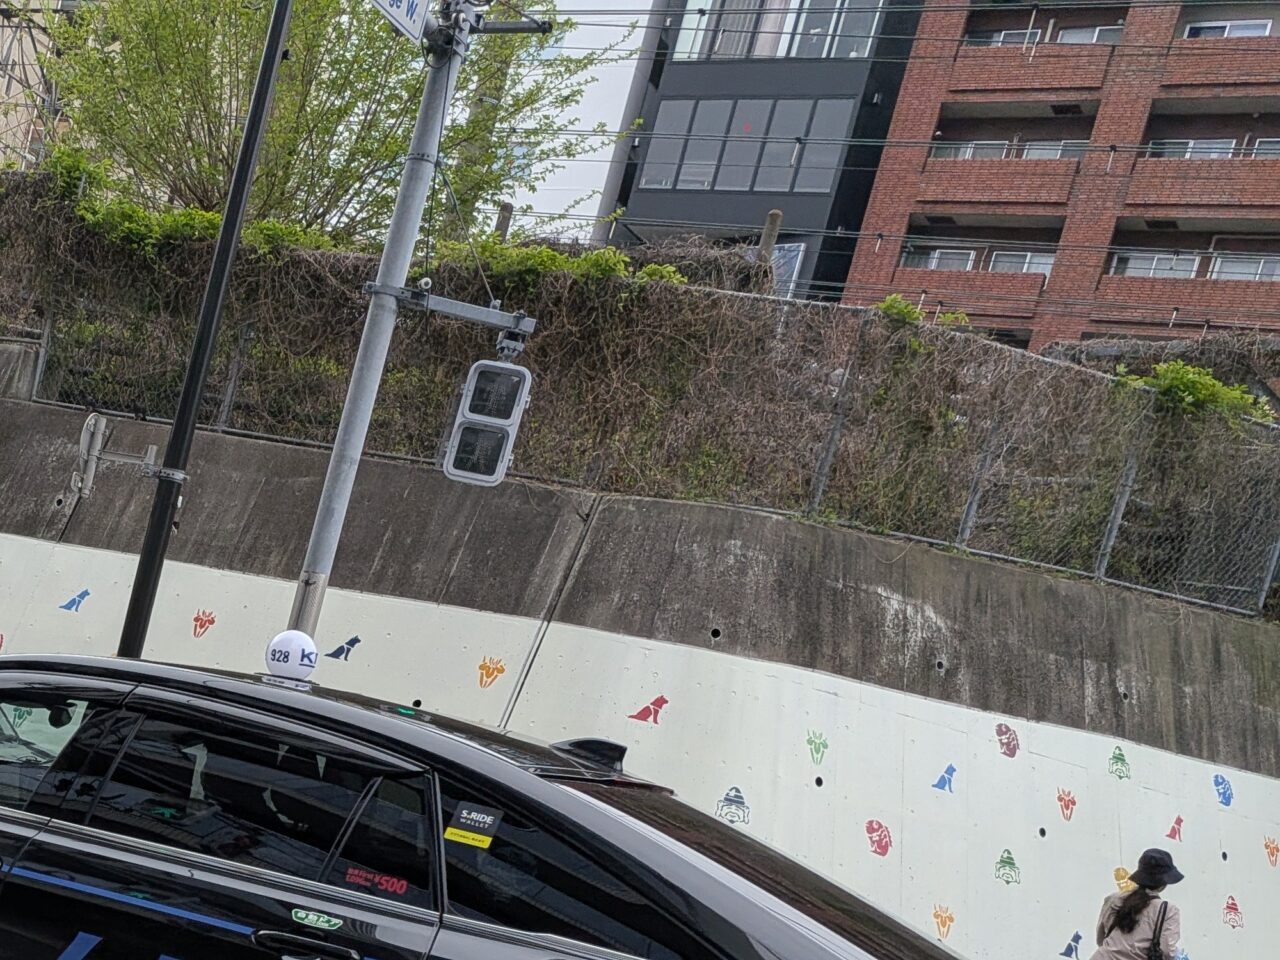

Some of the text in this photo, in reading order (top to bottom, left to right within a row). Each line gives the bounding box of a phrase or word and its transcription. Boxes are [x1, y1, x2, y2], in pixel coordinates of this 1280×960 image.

[270, 648, 290, 663] 928
[459, 817, 490, 830] WALLET
[460, 808, 495, 825] S.RIDE
